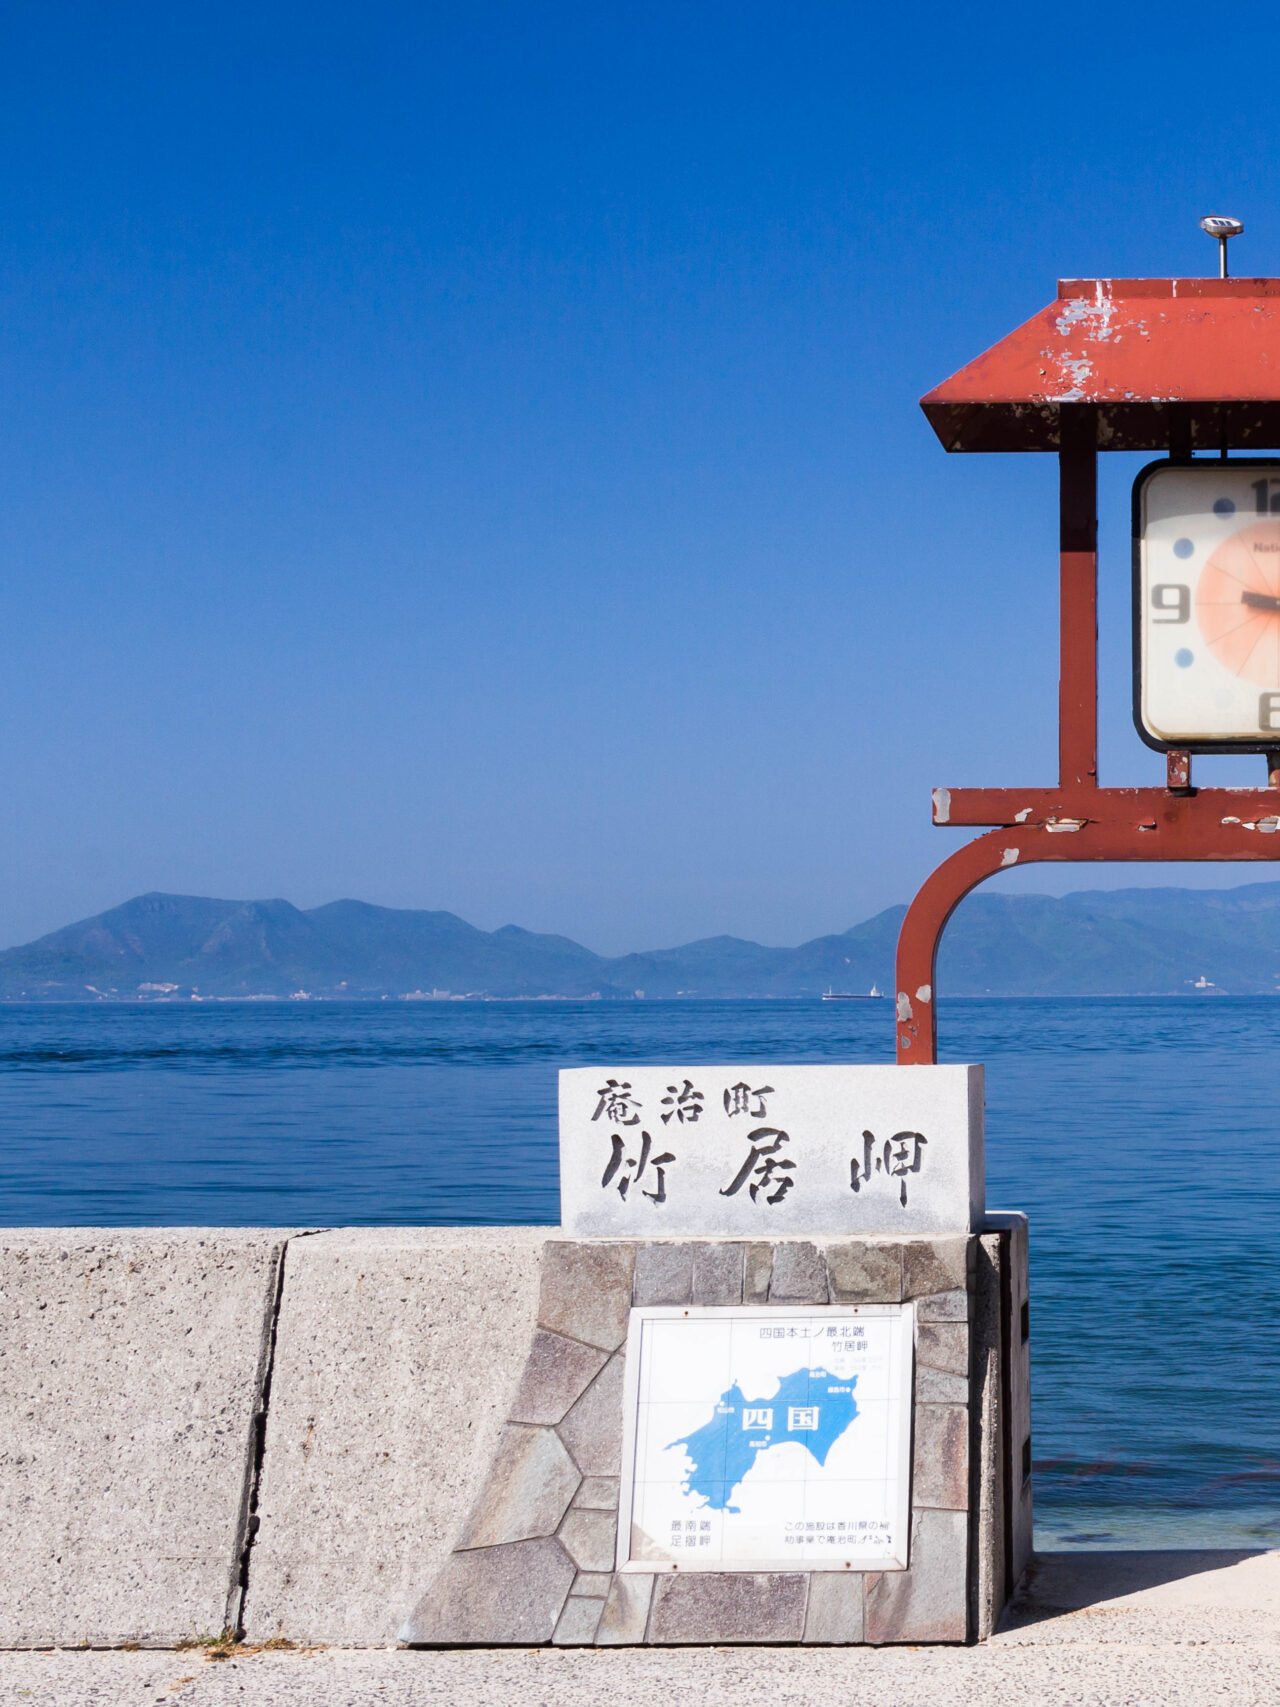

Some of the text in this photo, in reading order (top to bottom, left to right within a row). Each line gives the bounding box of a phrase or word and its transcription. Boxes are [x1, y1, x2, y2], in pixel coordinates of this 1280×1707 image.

[1151, 583, 1191, 625] 9
[591, 1079, 775, 1126] 庵治町
[601, 1127, 928, 1208] 竹居岬
[832, 1340, 868, 1352] 竹居岬
[742, 1406, 819, 1431] 四国
[671, 1520, 711, 1532] 最南端
[671, 1535, 711, 1548] 足摺岬
